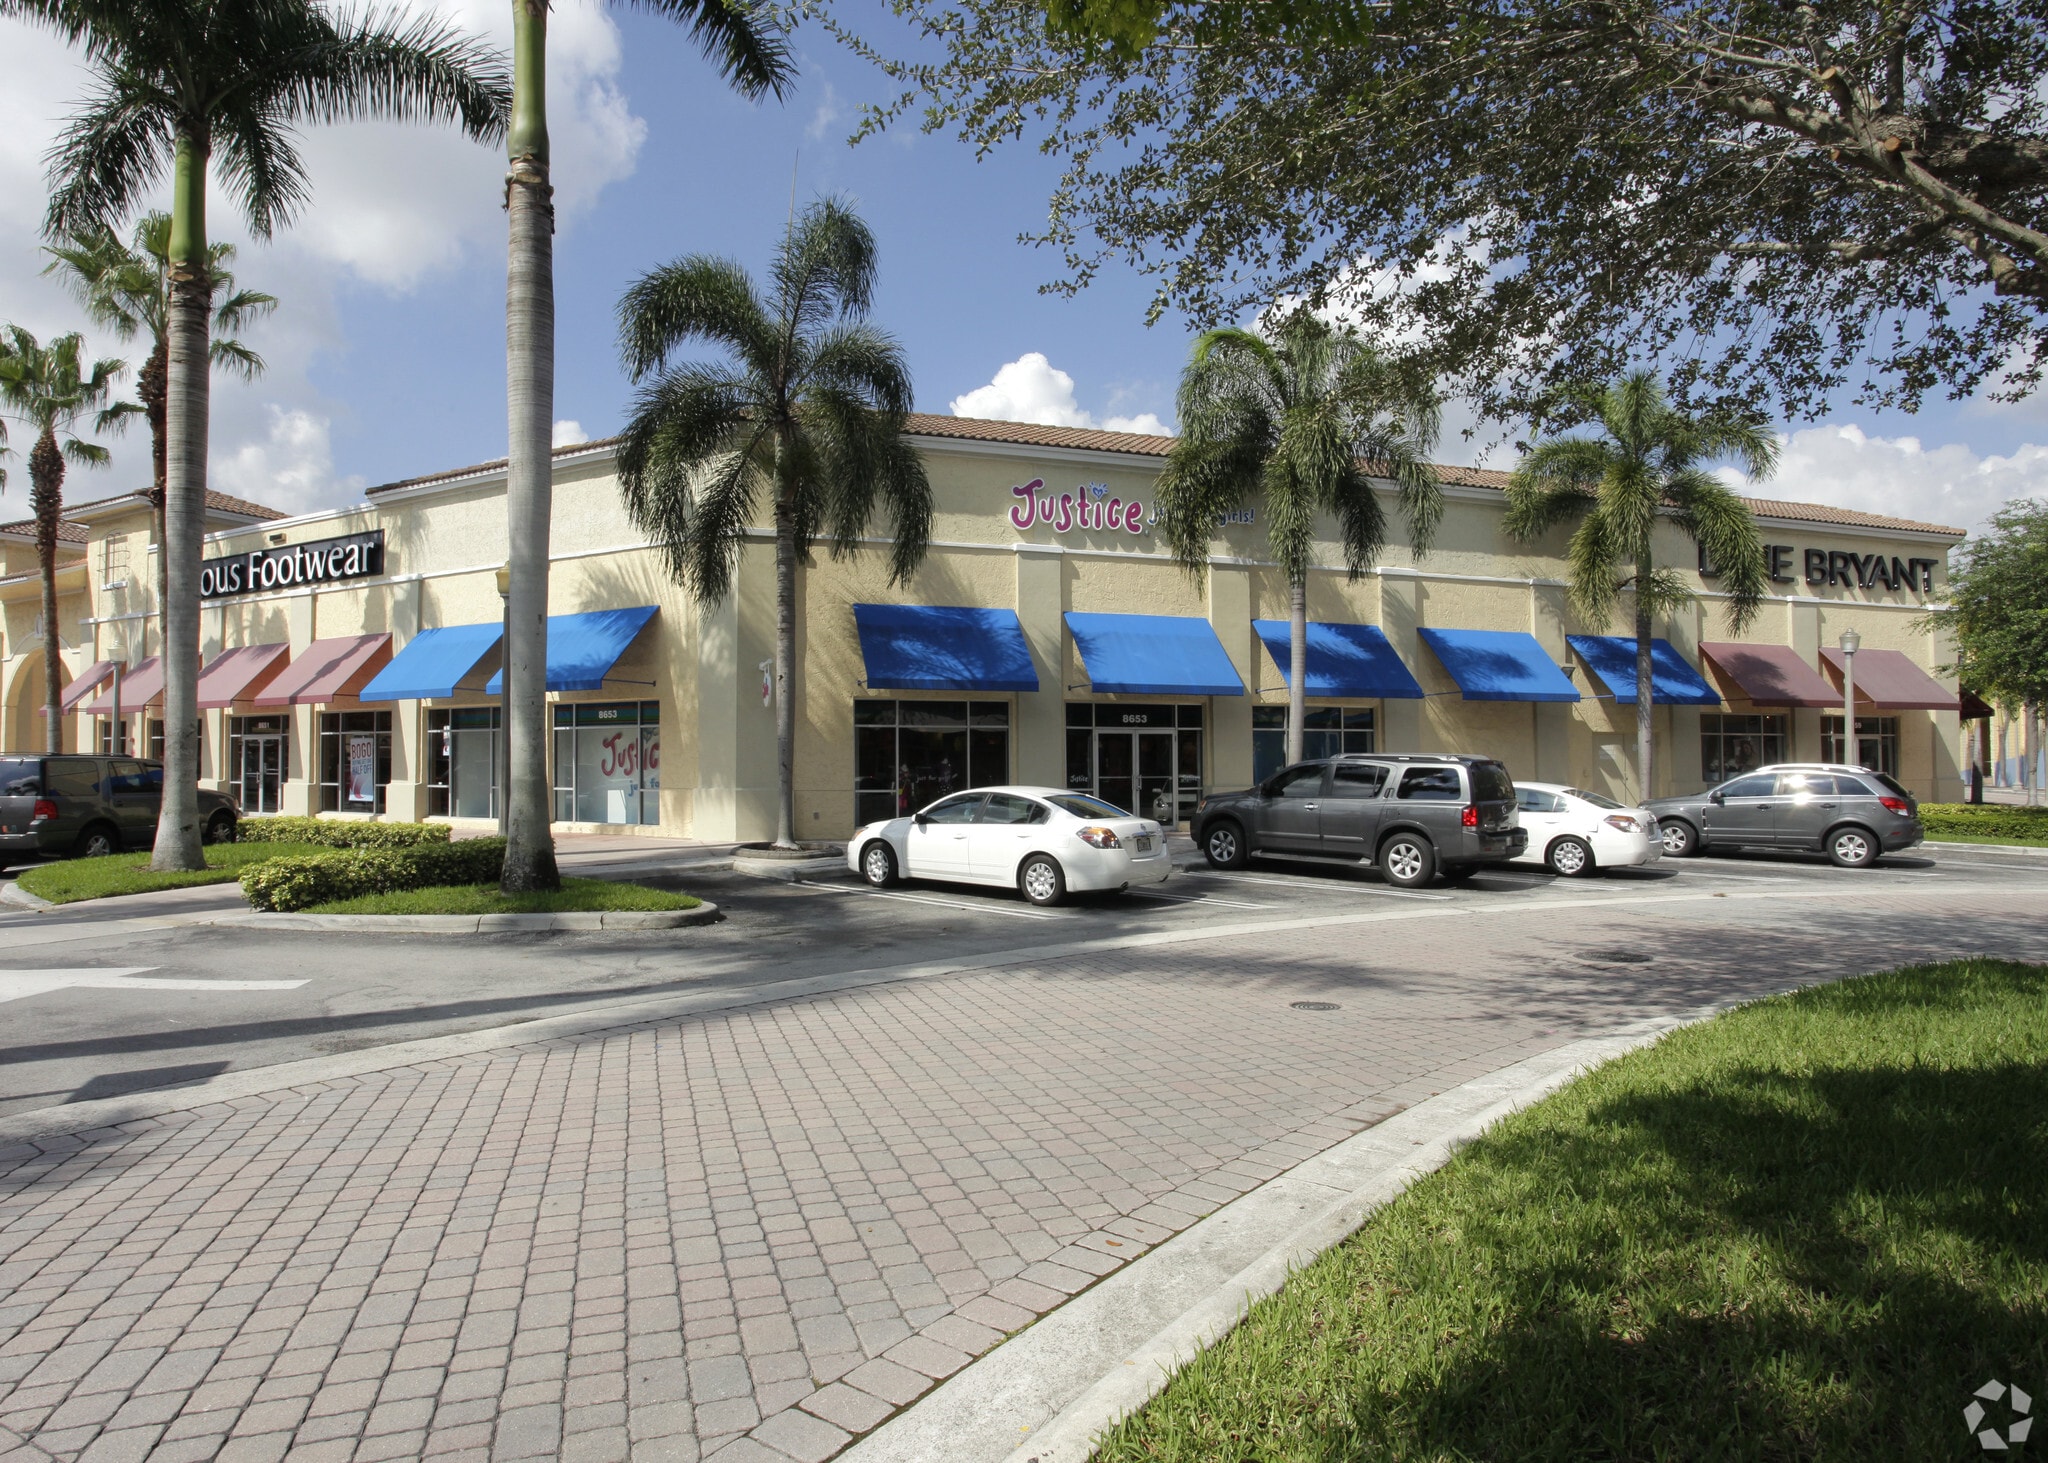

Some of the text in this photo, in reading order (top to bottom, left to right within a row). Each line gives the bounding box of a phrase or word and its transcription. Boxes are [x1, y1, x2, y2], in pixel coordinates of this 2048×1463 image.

[1008, 478, 1143, 534] Justice
[201, 541, 375, 597] ous Footwear
[1698, 541, 1939, 593] LE BRYANT
[598, 710, 618, 719] 8653
[1122, 714, 1148, 723] 8653
[351, 741, 372, 760] BOGO
[601, 732, 659, 776] Justic
